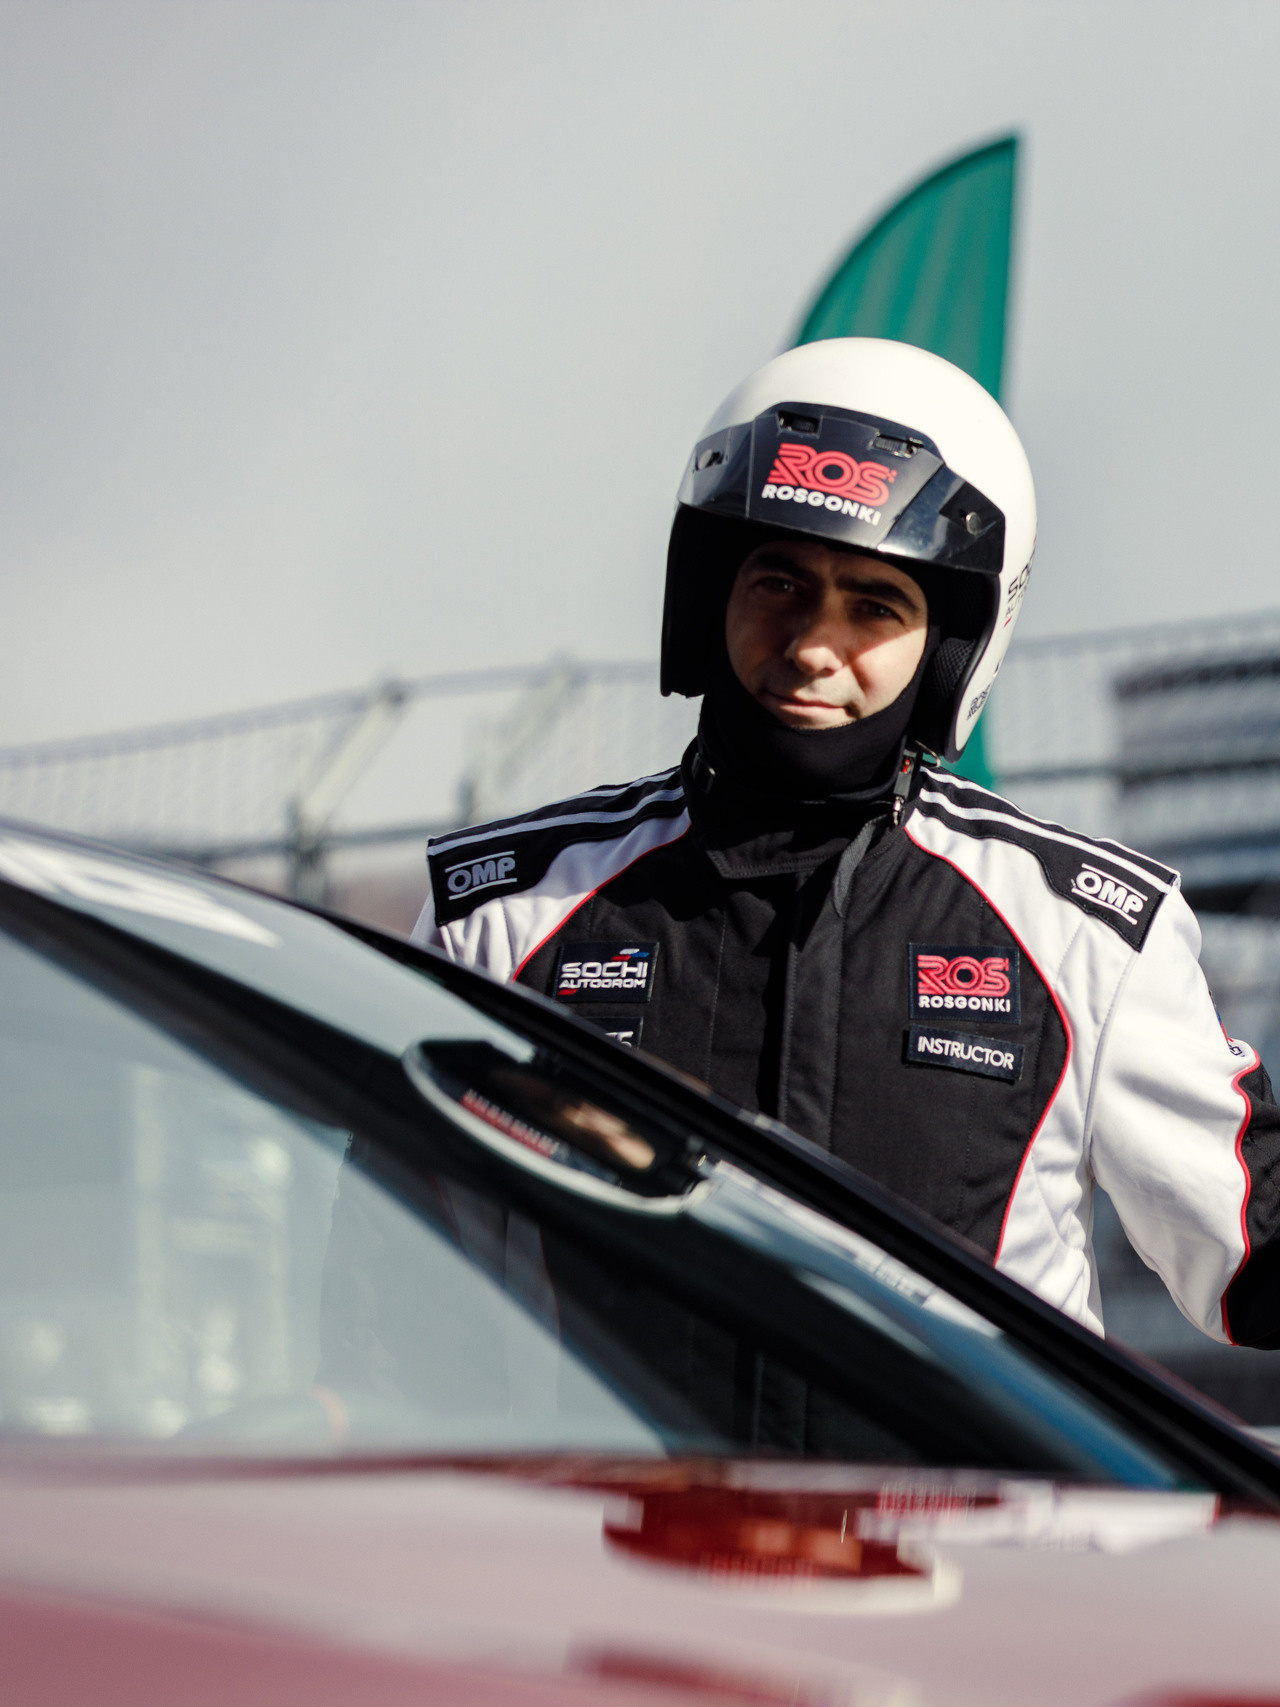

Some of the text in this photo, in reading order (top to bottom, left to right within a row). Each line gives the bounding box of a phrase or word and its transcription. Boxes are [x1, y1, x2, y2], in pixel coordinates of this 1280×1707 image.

[767, 443, 898, 507] ROS
[761, 483, 882, 526] ROSGONKI
[447, 856, 516, 893] OMP
[1075, 870, 1144, 914] OMP
[558, 977, 647, 989] AUTODROM
[560, 961, 649, 979] SOCHI
[917, 954, 1011, 997] ROS
[918, 995, 1011, 1014] ROSGONKI
[917, 1035, 1015, 1071] INSTRUCTOR
